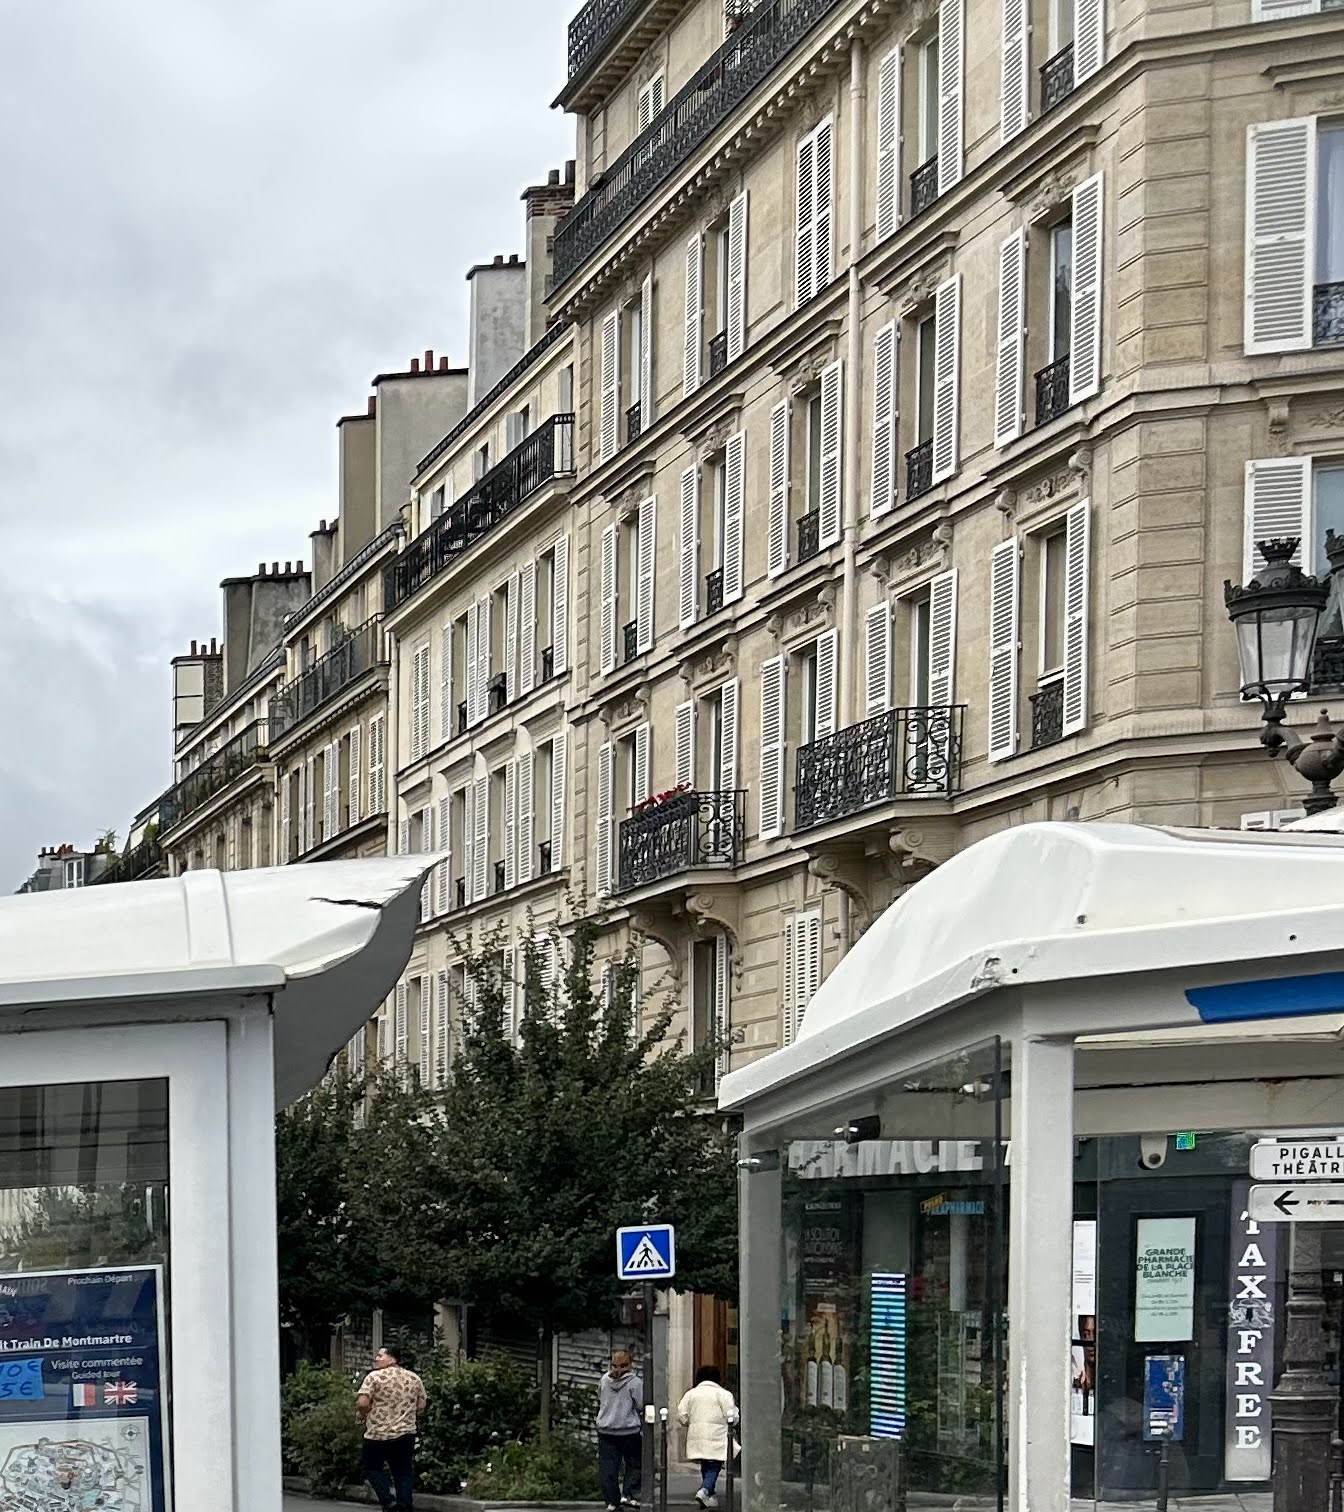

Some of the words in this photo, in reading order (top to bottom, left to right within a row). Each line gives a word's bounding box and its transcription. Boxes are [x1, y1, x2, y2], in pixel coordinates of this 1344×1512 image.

[1143, 1270, 1188, 1278] BLANCHE
[10, 1338, 42, 1351] Train
[44, 1337, 60, 1349] De
[62, 1334, 133, 1348] Montmartre
[51, 1358, 80, 1371] Visite
[81, 1356, 144, 1369] commentée
[72, 1371, 102, 1381] Guided
[1234, 1330, 1265, 1450] FREE
